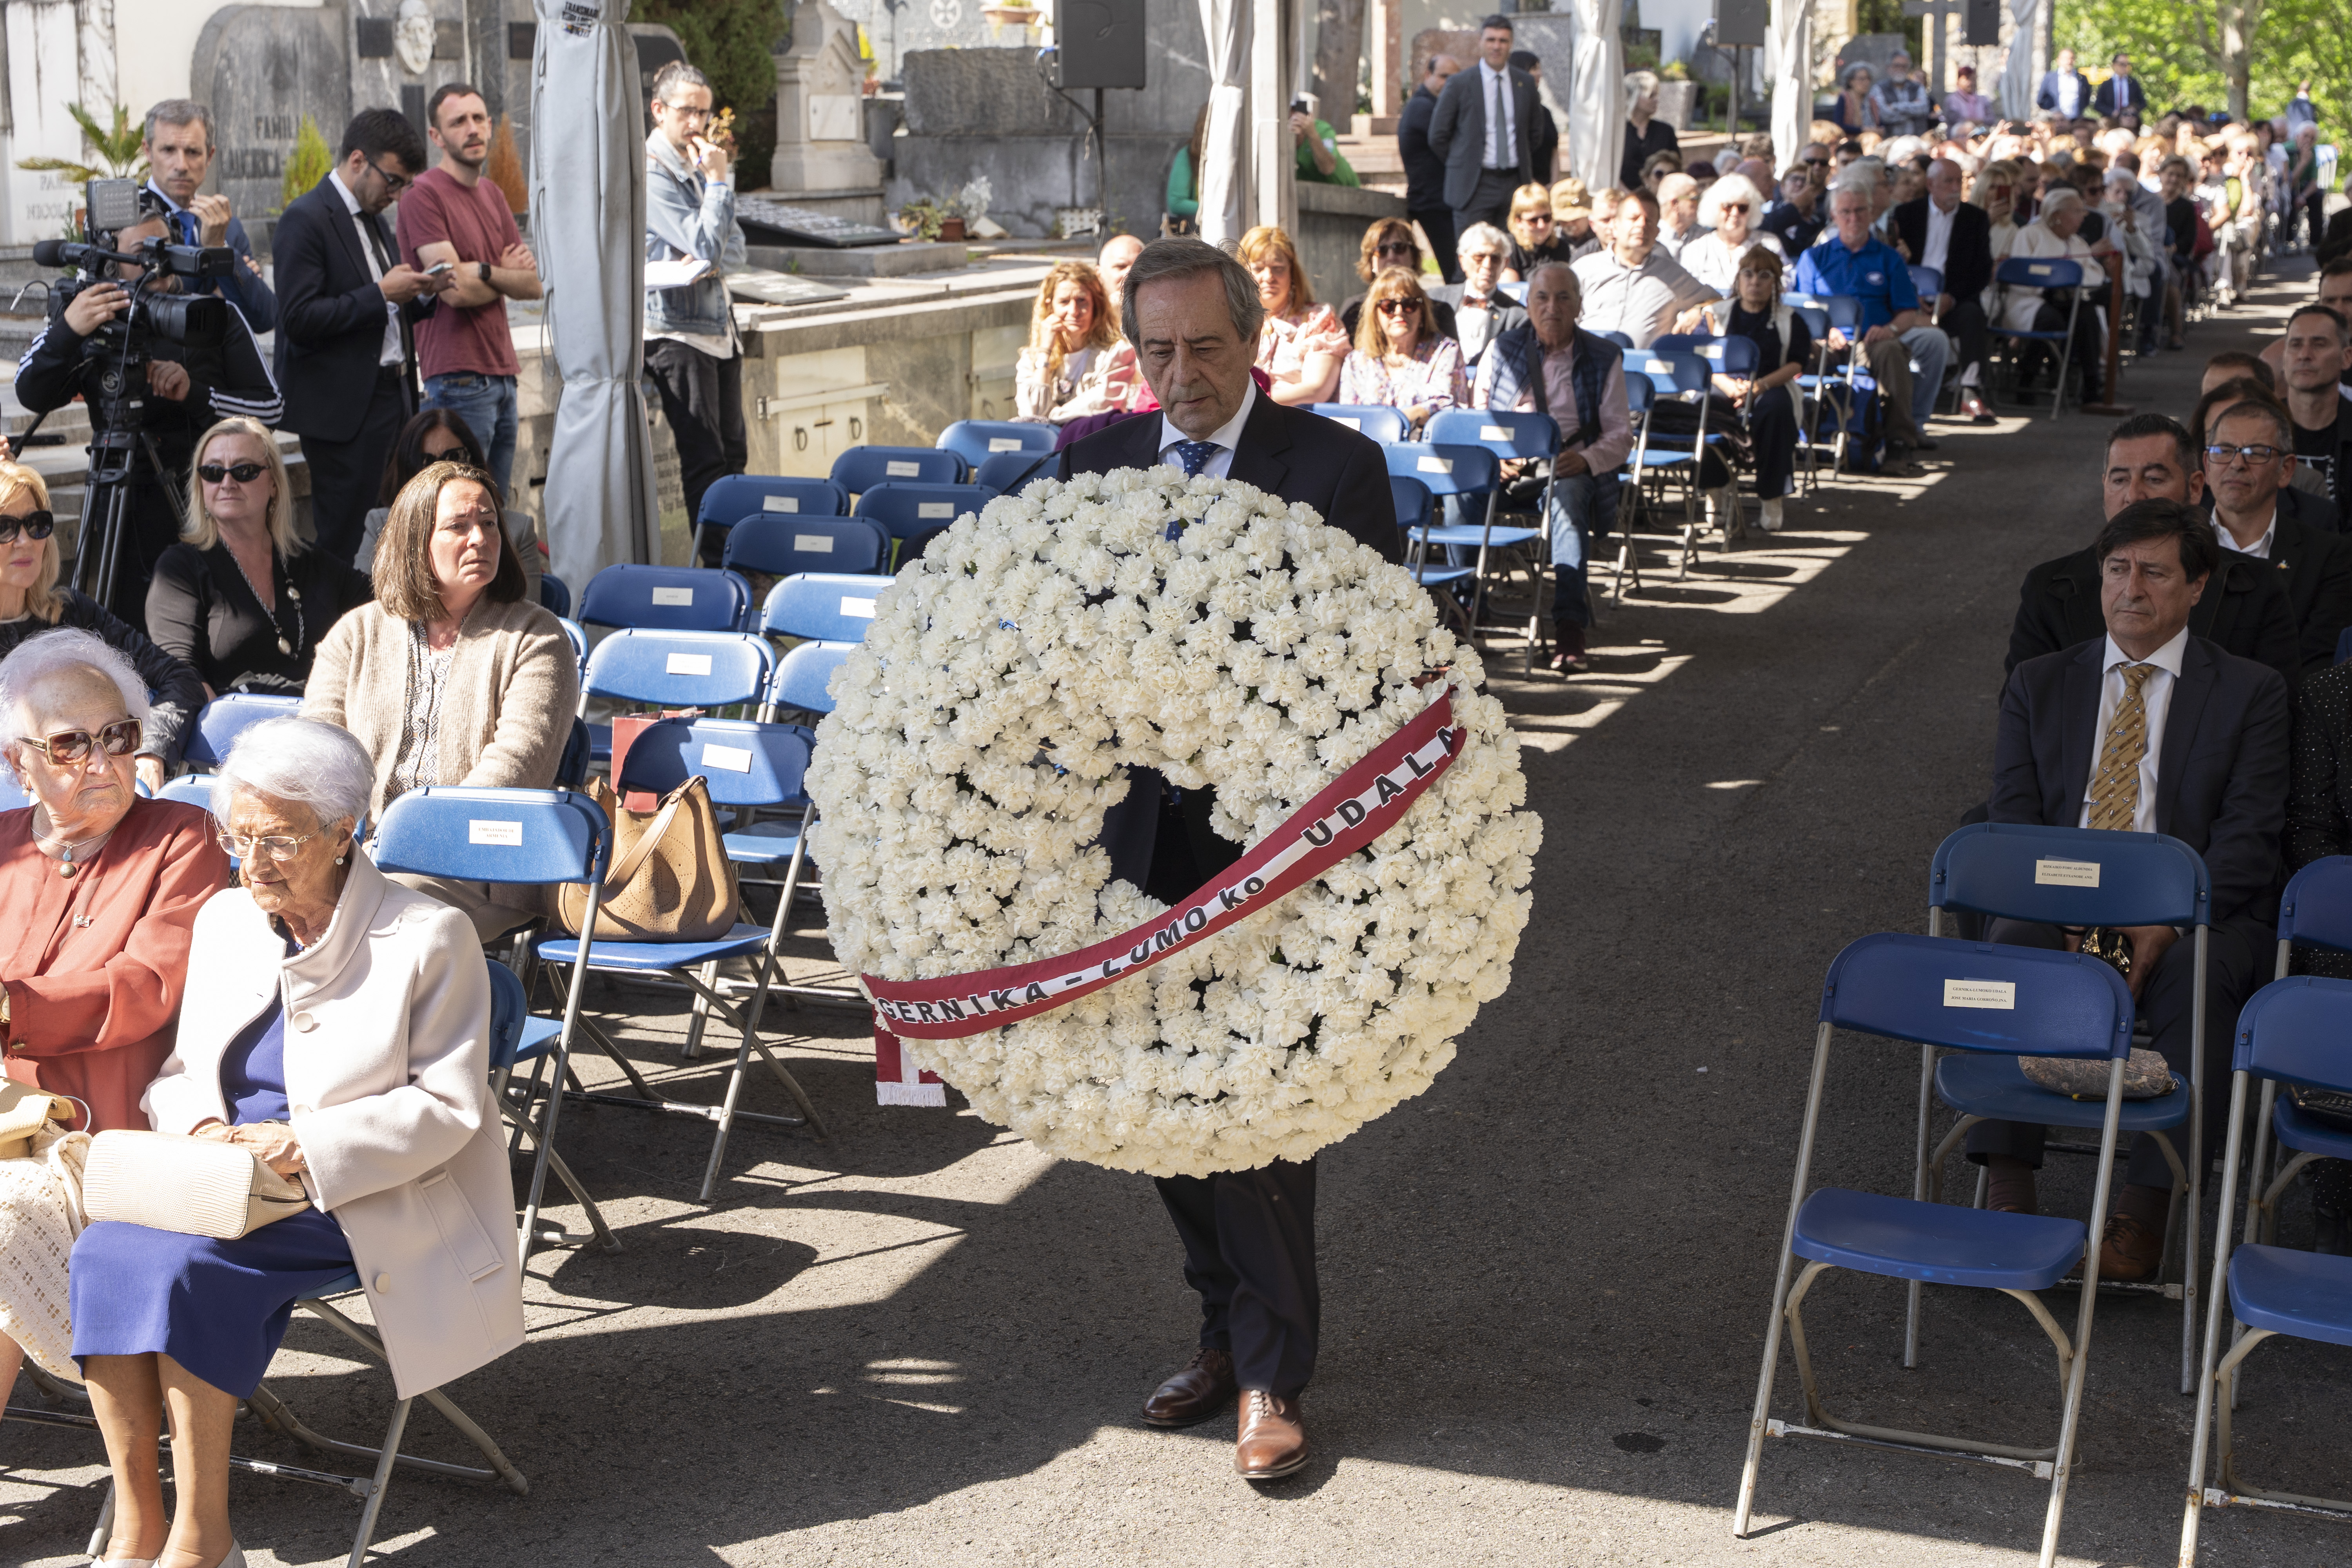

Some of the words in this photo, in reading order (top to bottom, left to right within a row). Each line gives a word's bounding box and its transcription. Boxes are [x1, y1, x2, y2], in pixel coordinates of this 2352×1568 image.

[255, 116, 301, 140] FAMILI
[877, 981, 1052, 1024] GERNIKA
[1102, 906, 1209, 980] LUMO
[1300, 725, 1454, 848] UDALA
